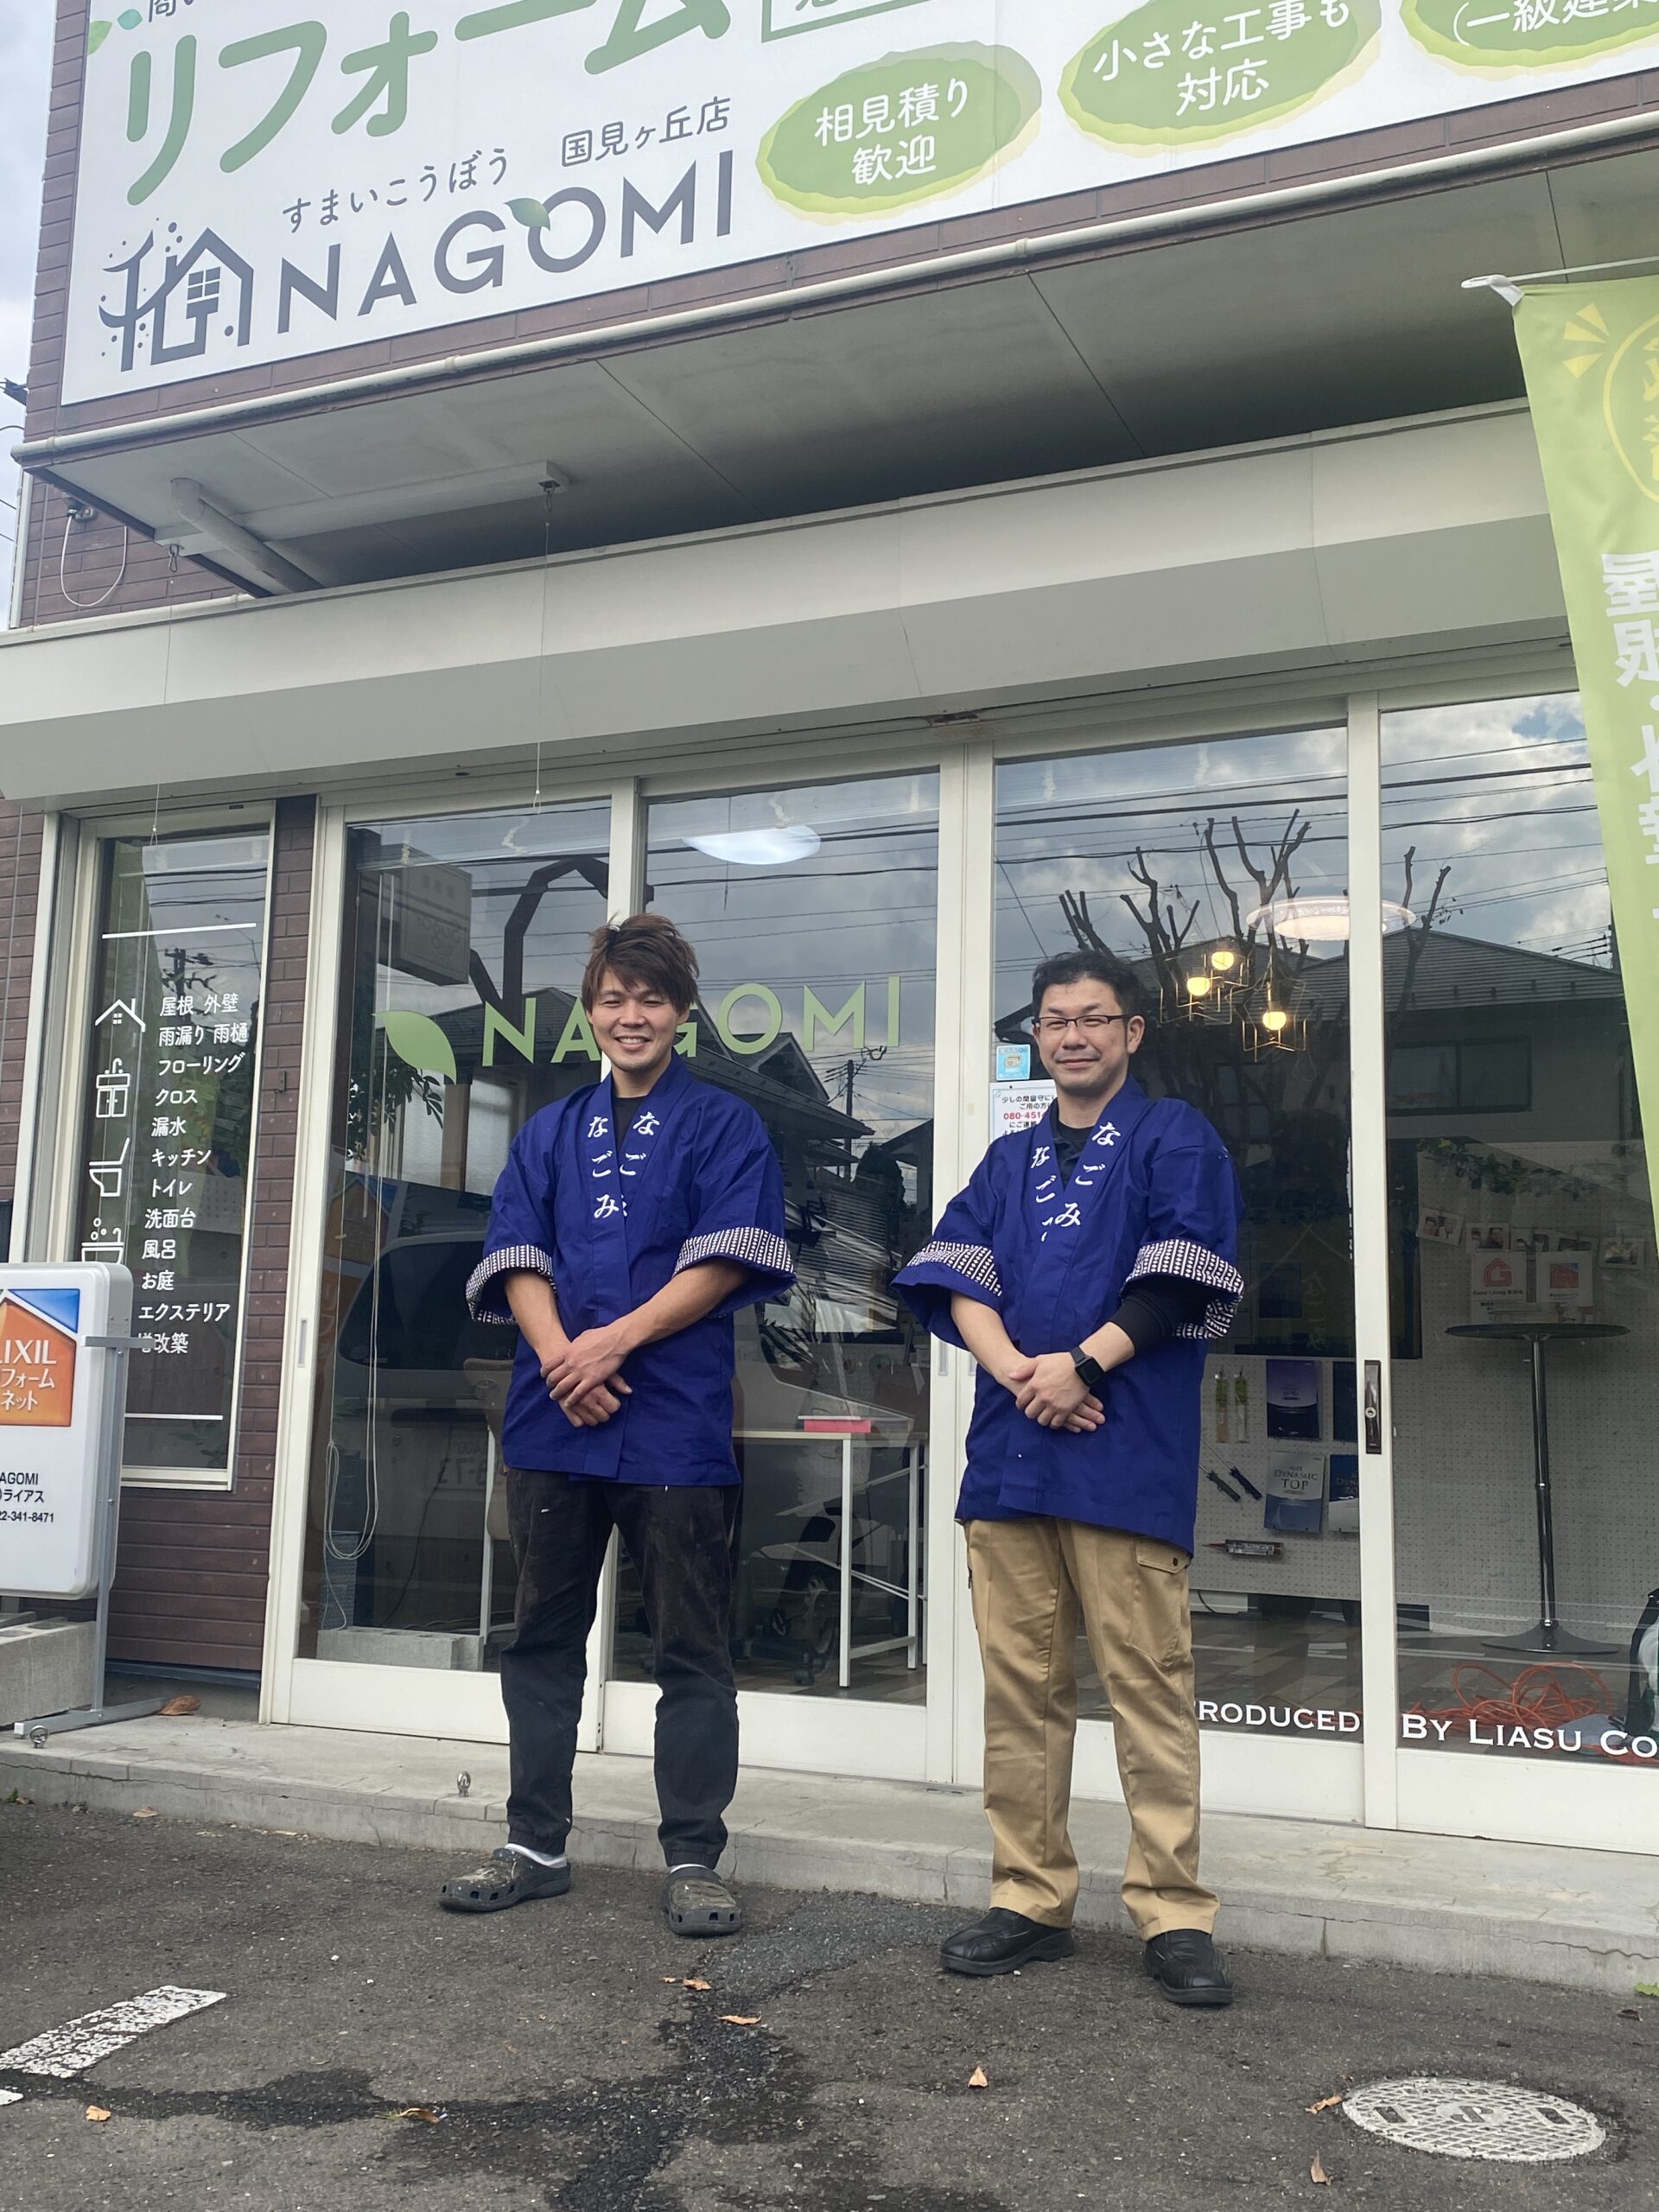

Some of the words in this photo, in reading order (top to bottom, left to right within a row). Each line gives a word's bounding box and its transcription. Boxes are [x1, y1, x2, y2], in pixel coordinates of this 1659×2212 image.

[1093, 0, 1349, 81] 小さな工事も
[1176, 58, 1269, 116] 対応
[815, 78, 968, 147] 相見積り
[562, 96, 731, 167] 国見ヶ丘店
[851, 134, 937, 185] 歓迎
[283, 149, 507, 233] すまいこうぼう
[277, 149, 734, 334] NAGOMI
[160, 996, 194, 1016] 屋根
[204, 993, 238, 1014] 外壁
[159, 1025, 204, 1046] 雨漏り
[213, 1022, 248, 1043] 雨樋
[159, 1052, 245, 1075] フローリング
[155, 1089, 198, 1106] クロス
[151, 1116, 186, 1136] 漏水
[1003, 1111, 1043, 1121] 080-451
[151, 1149, 212, 1167] キッチン
[588, 1116, 620, 1219] なごみ
[1055, 1122, 1122, 1227] なごみ
[153, 1179, 192, 1197] トイレ
[145, 1207, 196, 1229] 洗面台
[142, 1240, 175, 1260] 風呂
[143, 1270, 175, 1291] お庭
[139, 1303, 231, 1322] エクステリア
[0, 1339, 57, 1364] IXIL
[0, 1389, 38, 1411] ネット
[1274, 1469, 1318, 1481] DYNAMIC
[1281, 1478, 1309, 1490] TOP
[1194, 1700, 1361, 1733] RODUCED
